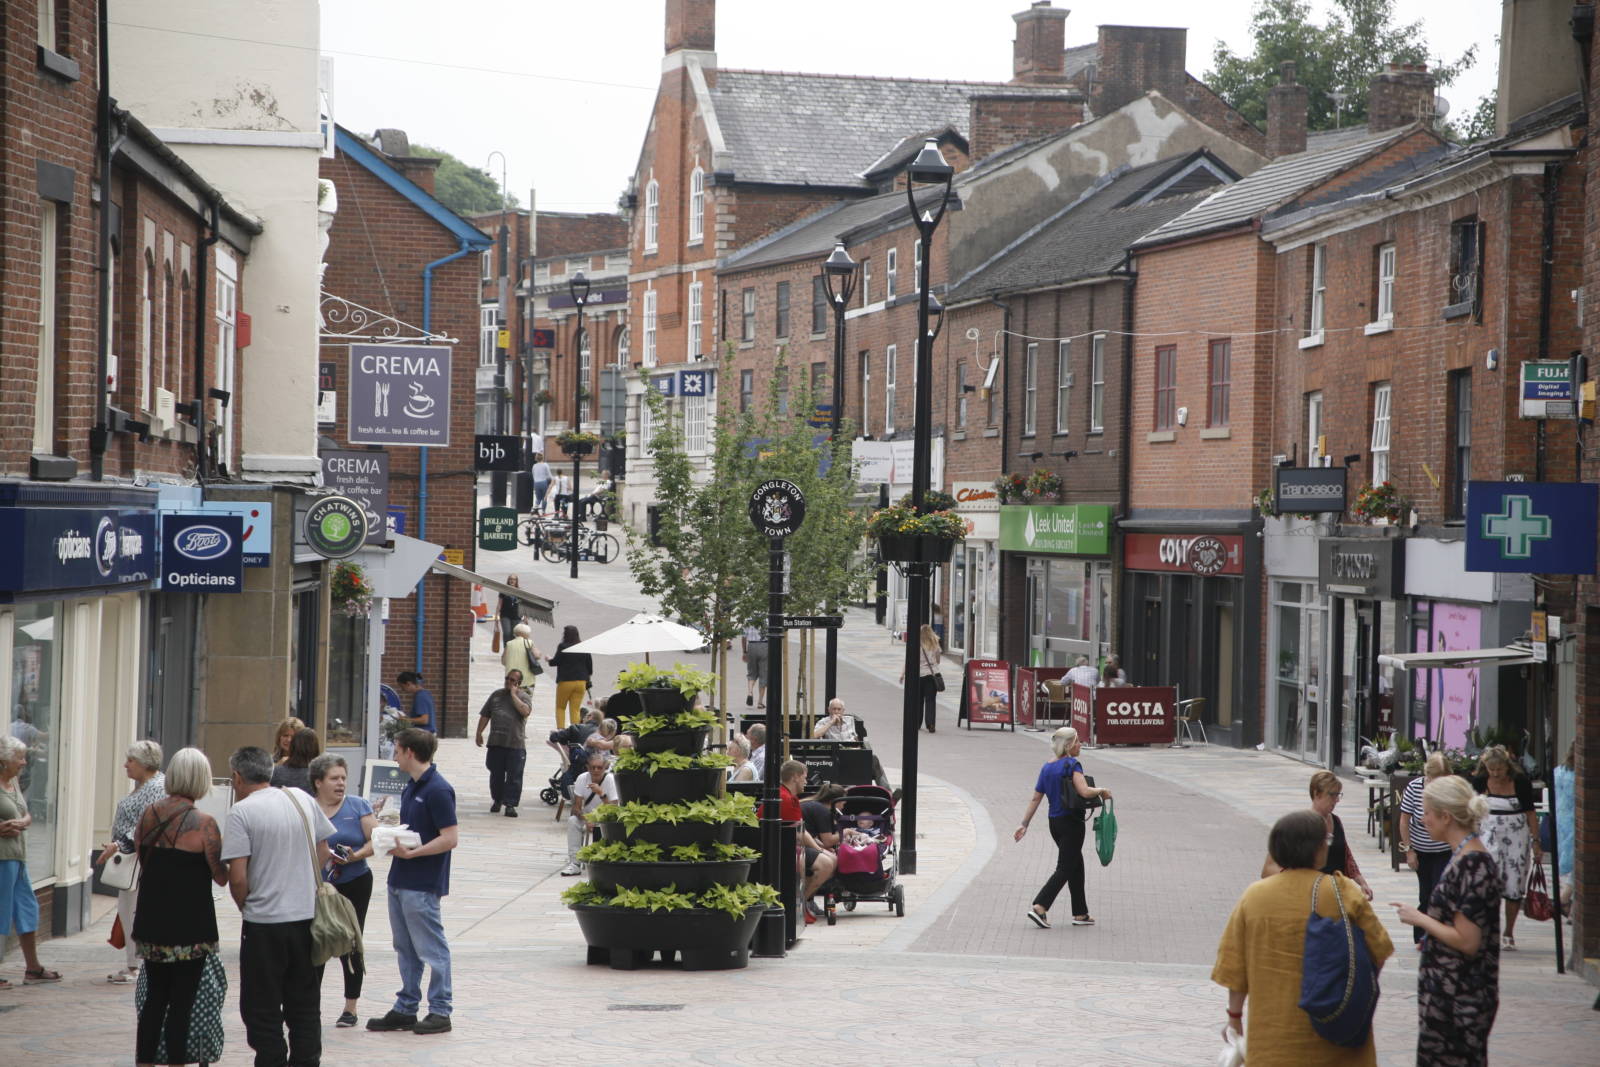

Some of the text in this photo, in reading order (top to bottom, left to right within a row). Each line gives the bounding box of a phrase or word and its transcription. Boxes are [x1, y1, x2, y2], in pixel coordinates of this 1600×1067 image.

[360, 355, 441, 376] CREMA
[357, 426, 374, 434] fresh
[391, 427, 402, 435] tea
[403, 427, 409, 435] &
[409, 427, 429, 435] coffee
[429, 427, 441, 436] bar
[479, 442, 505, 463] bjb
[327, 458, 381, 474] CREMA
[336, 475, 354, 483] fresh
[347, 486, 369, 494] coffee
[370, 487, 382, 495] bar
[753, 481, 802, 501] CONGLETON
[313, 502, 360, 526] CHATWINS
[484, 517, 514, 526] HOLLAND
[1035, 512, 1075, 533] Leek United
[483, 532, 513, 541] BARRETT
[764, 526, 792, 537] TOWN
[59, 529, 91, 565] opticians
[182, 532, 221, 551] Boots
[1194, 540, 1220, 552] COSTA
[1193, 559, 1224, 573] COFFEE
[168, 572, 236, 587] Opticians
[1073, 698, 1088, 715] COSTA
[1106, 701, 1165, 717] COSTA
